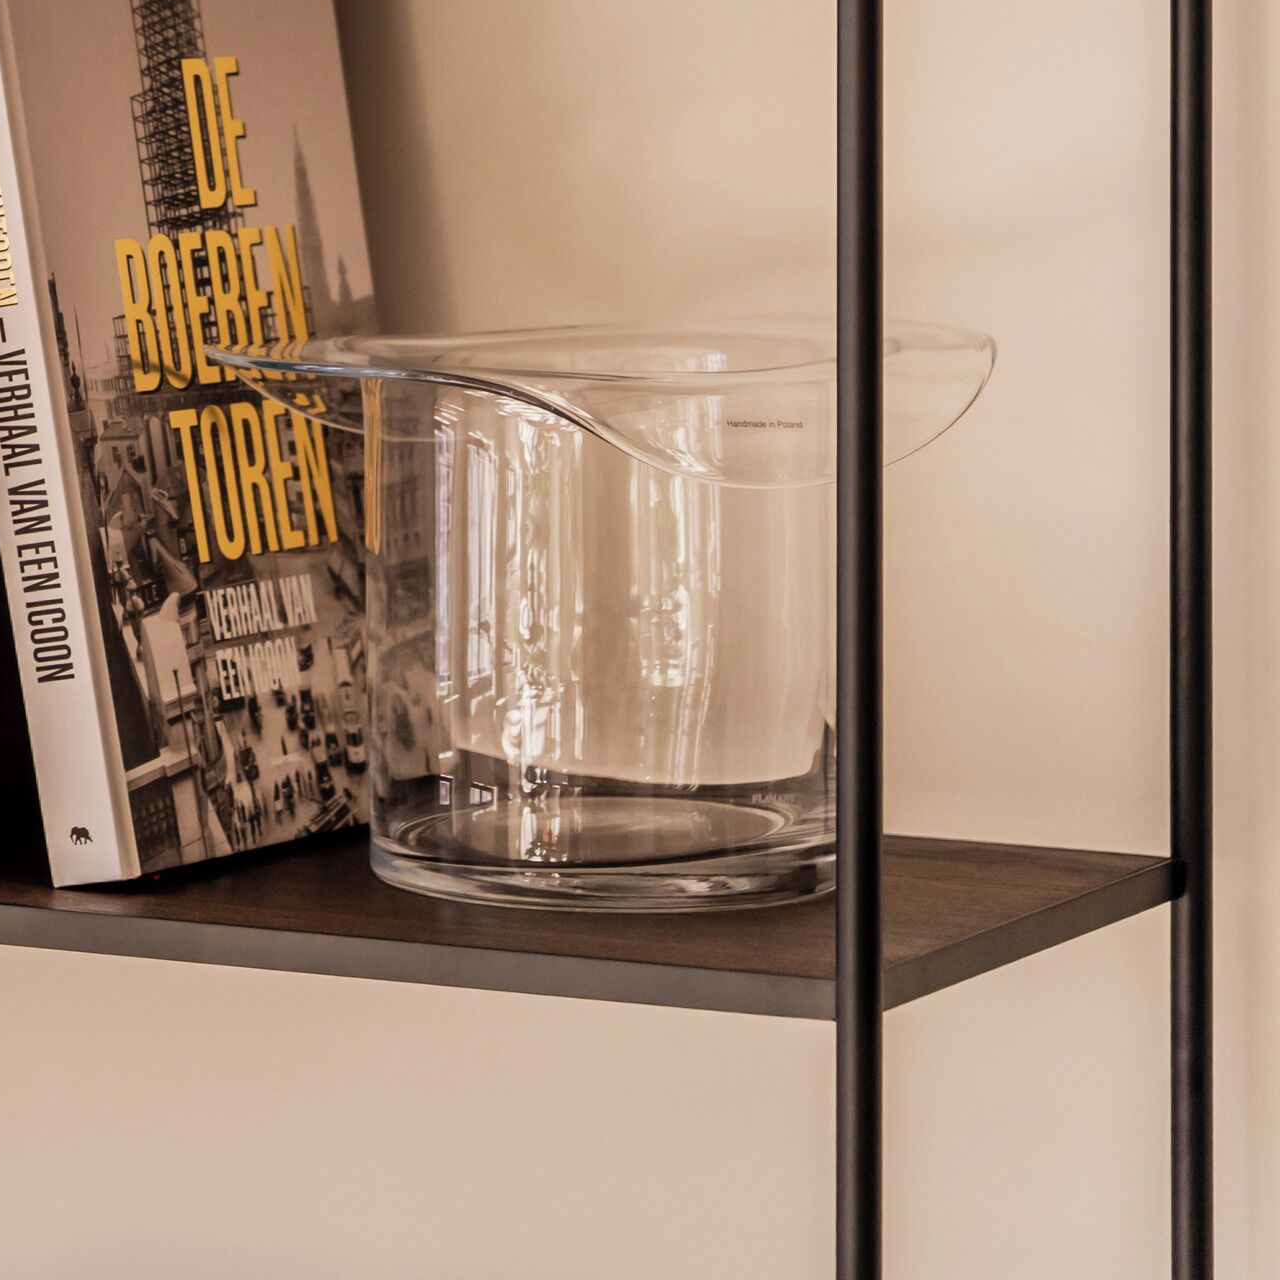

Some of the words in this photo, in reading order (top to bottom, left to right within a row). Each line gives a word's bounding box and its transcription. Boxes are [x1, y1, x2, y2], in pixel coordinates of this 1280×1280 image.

[180, 55, 257, 209] DE
[114, 224, 318, 393] BOEREN
[726, 419, 767, 429] Handmade
[776, 420, 803, 429] Poland
[8, 477, 46, 536] VAN
[169, 400, 338, 564] TOREN
[15, 540, 62, 591] EEN
[206, 580, 285, 642] VERHAAL
[279, 573, 319, 627] VAN
[29, 603, 75, 684] ICOON
[215, 645, 252, 701] EEN
[248, 635, 302, 695] ICOON
